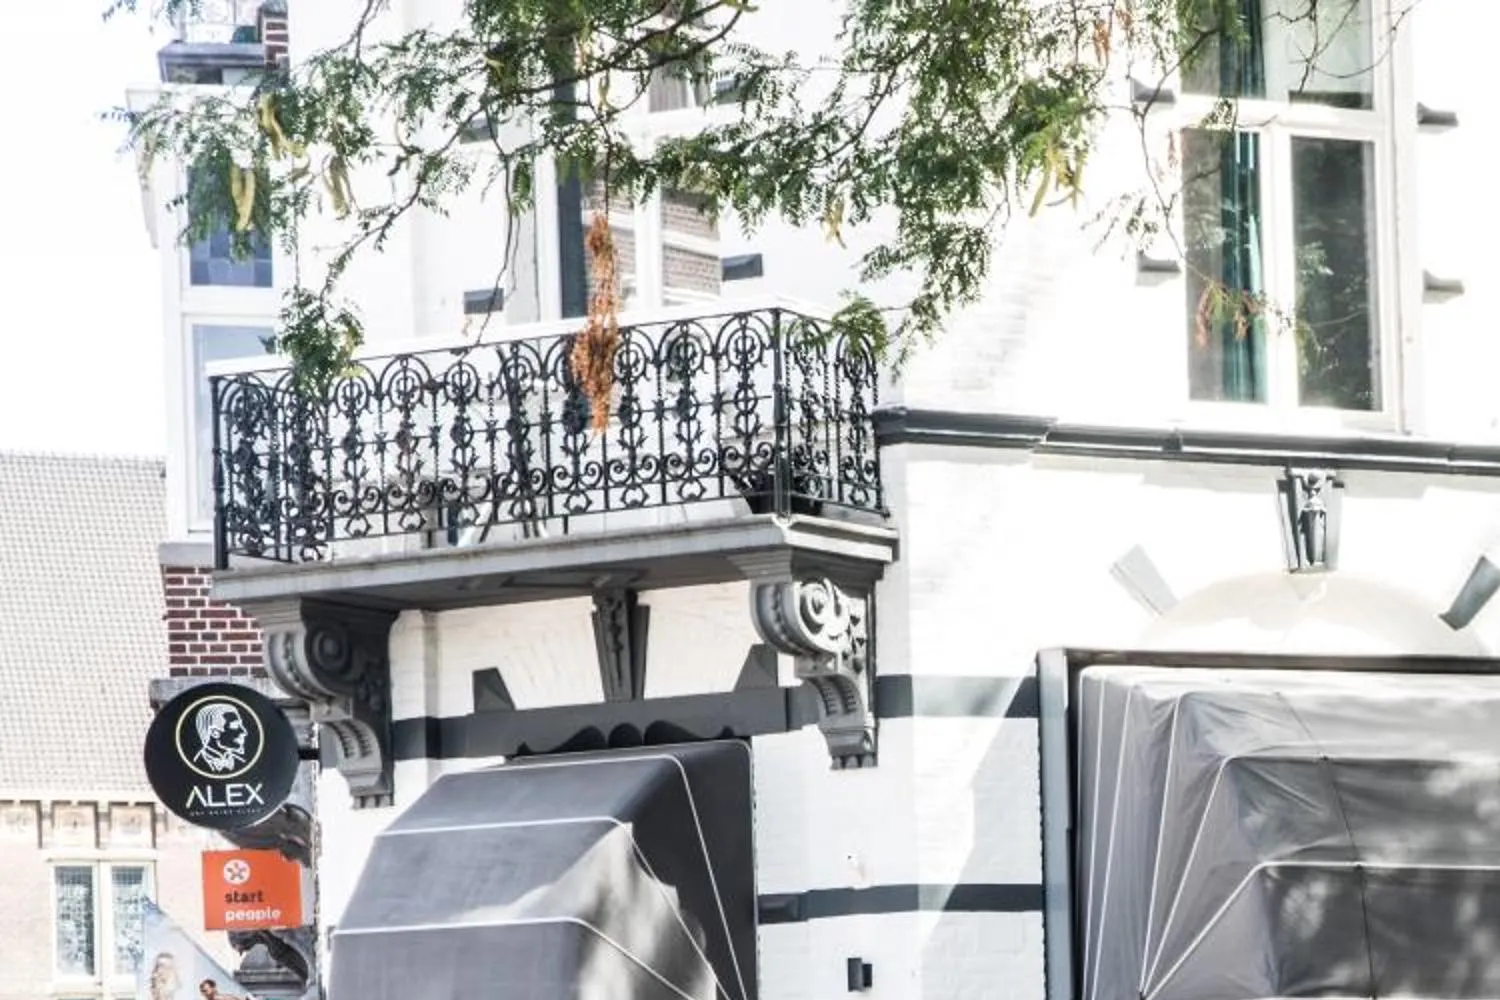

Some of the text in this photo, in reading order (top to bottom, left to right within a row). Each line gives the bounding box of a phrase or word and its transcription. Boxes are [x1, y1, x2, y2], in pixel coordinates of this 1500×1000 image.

[185, 783, 265, 809] ALEX
[225, 889, 264, 904] start
[225, 905, 281, 924] people
